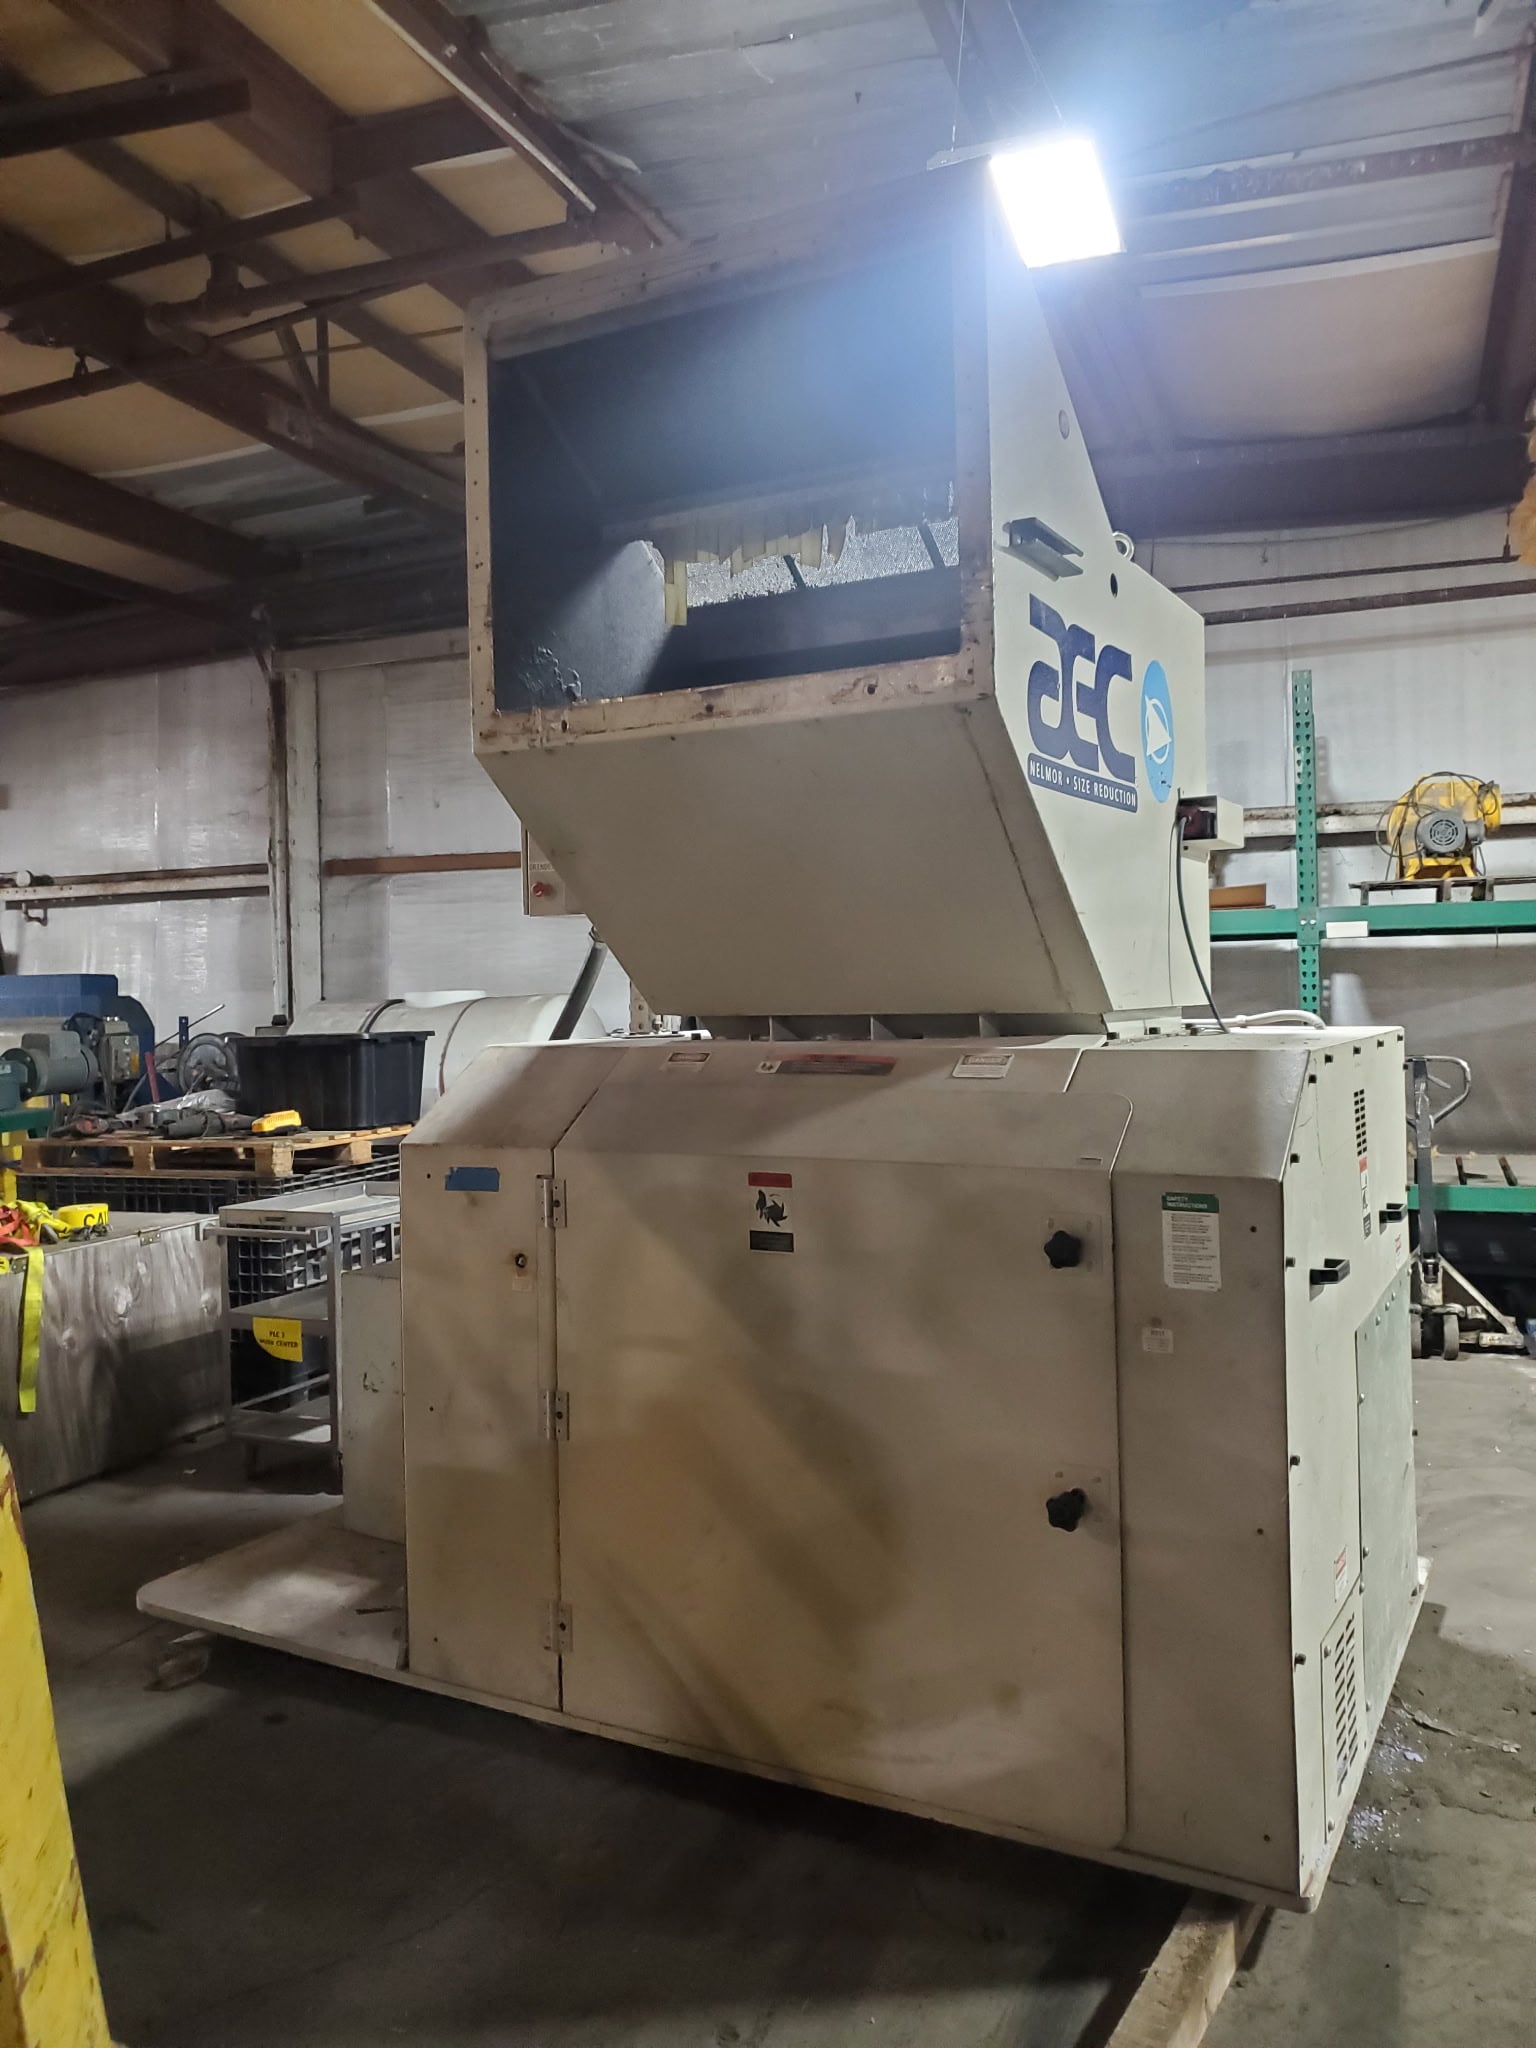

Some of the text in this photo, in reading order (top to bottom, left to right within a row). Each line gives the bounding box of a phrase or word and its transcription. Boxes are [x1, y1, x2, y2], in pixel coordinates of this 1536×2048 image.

[1029, 759, 1137, 808] NELMOR SIZE REDUCTION
[276, 1340, 298, 1348] CENTER
